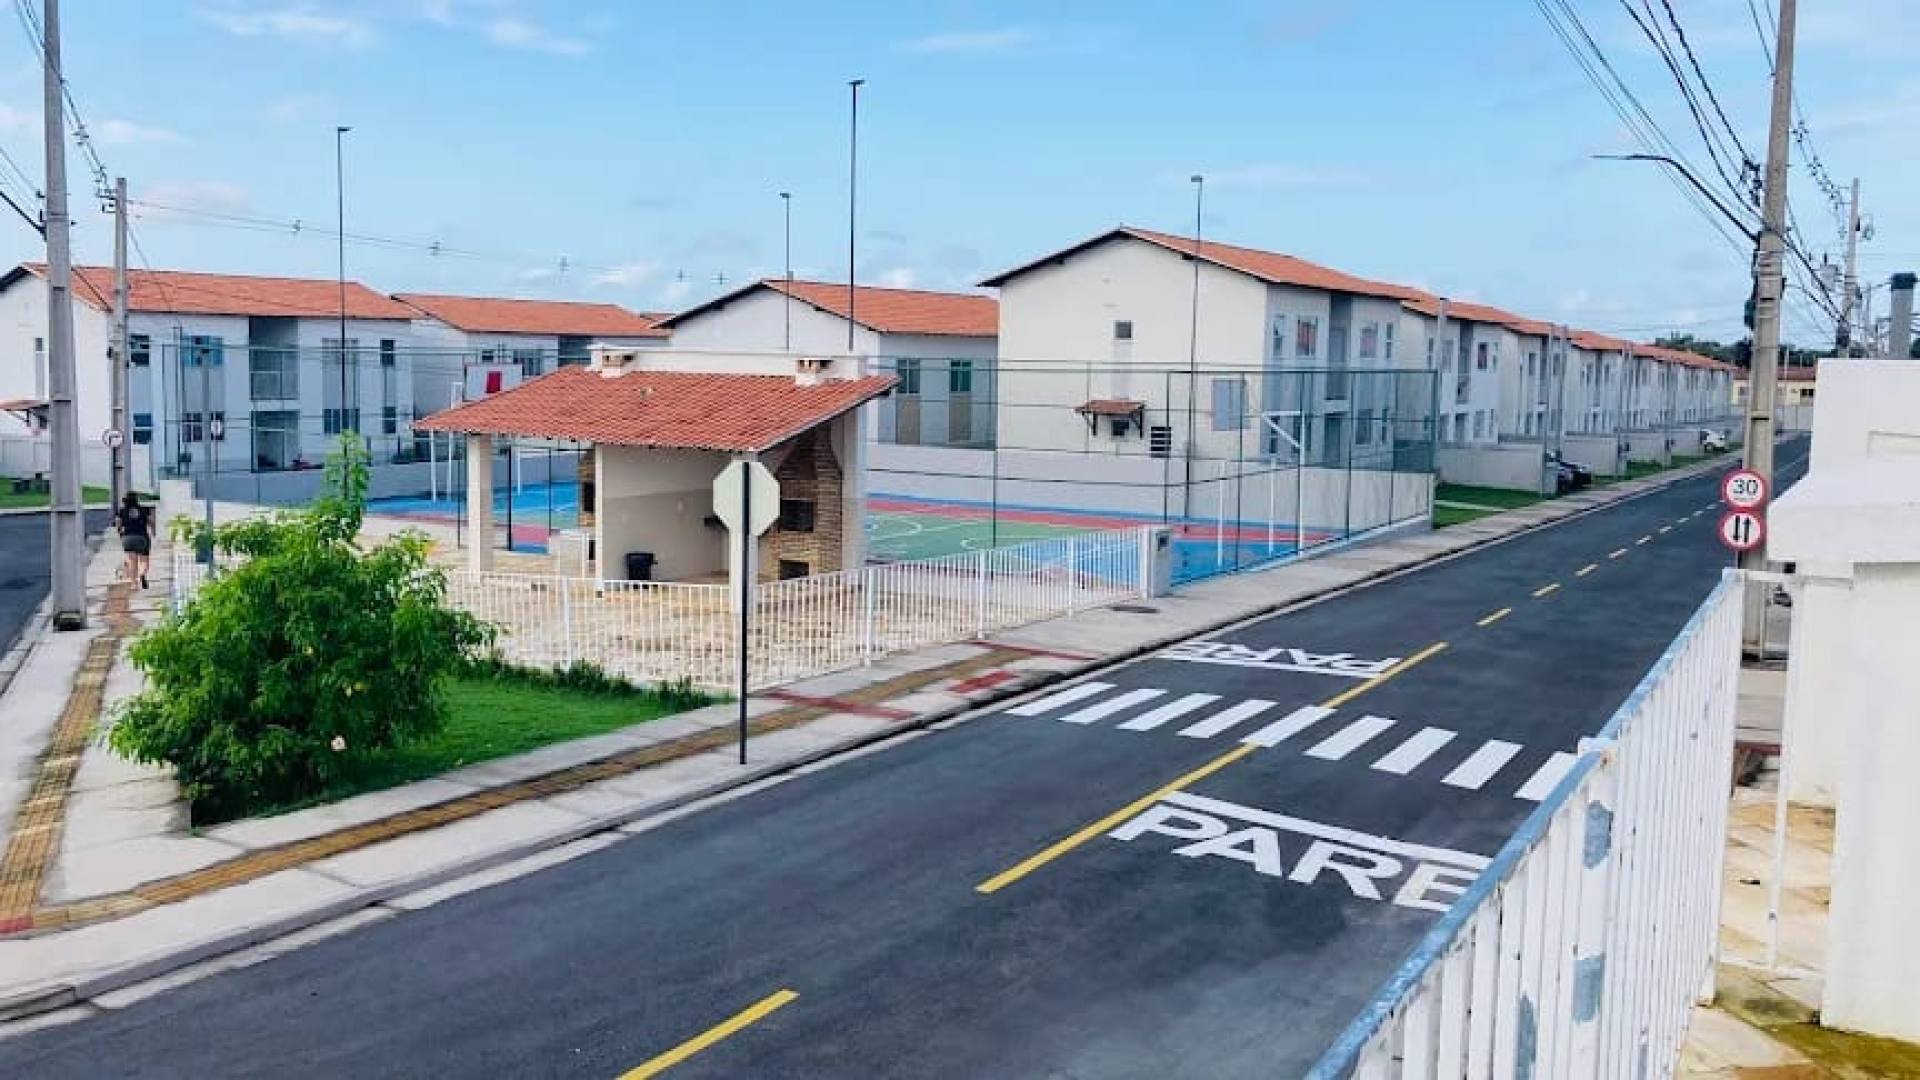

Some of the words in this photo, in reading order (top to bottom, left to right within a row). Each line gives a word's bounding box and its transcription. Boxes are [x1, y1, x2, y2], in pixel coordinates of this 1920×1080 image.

[1733, 479, 1758, 495] 30
[1158, 641, 1402, 674] PARE
[1107, 803, 1481, 911] PARE
